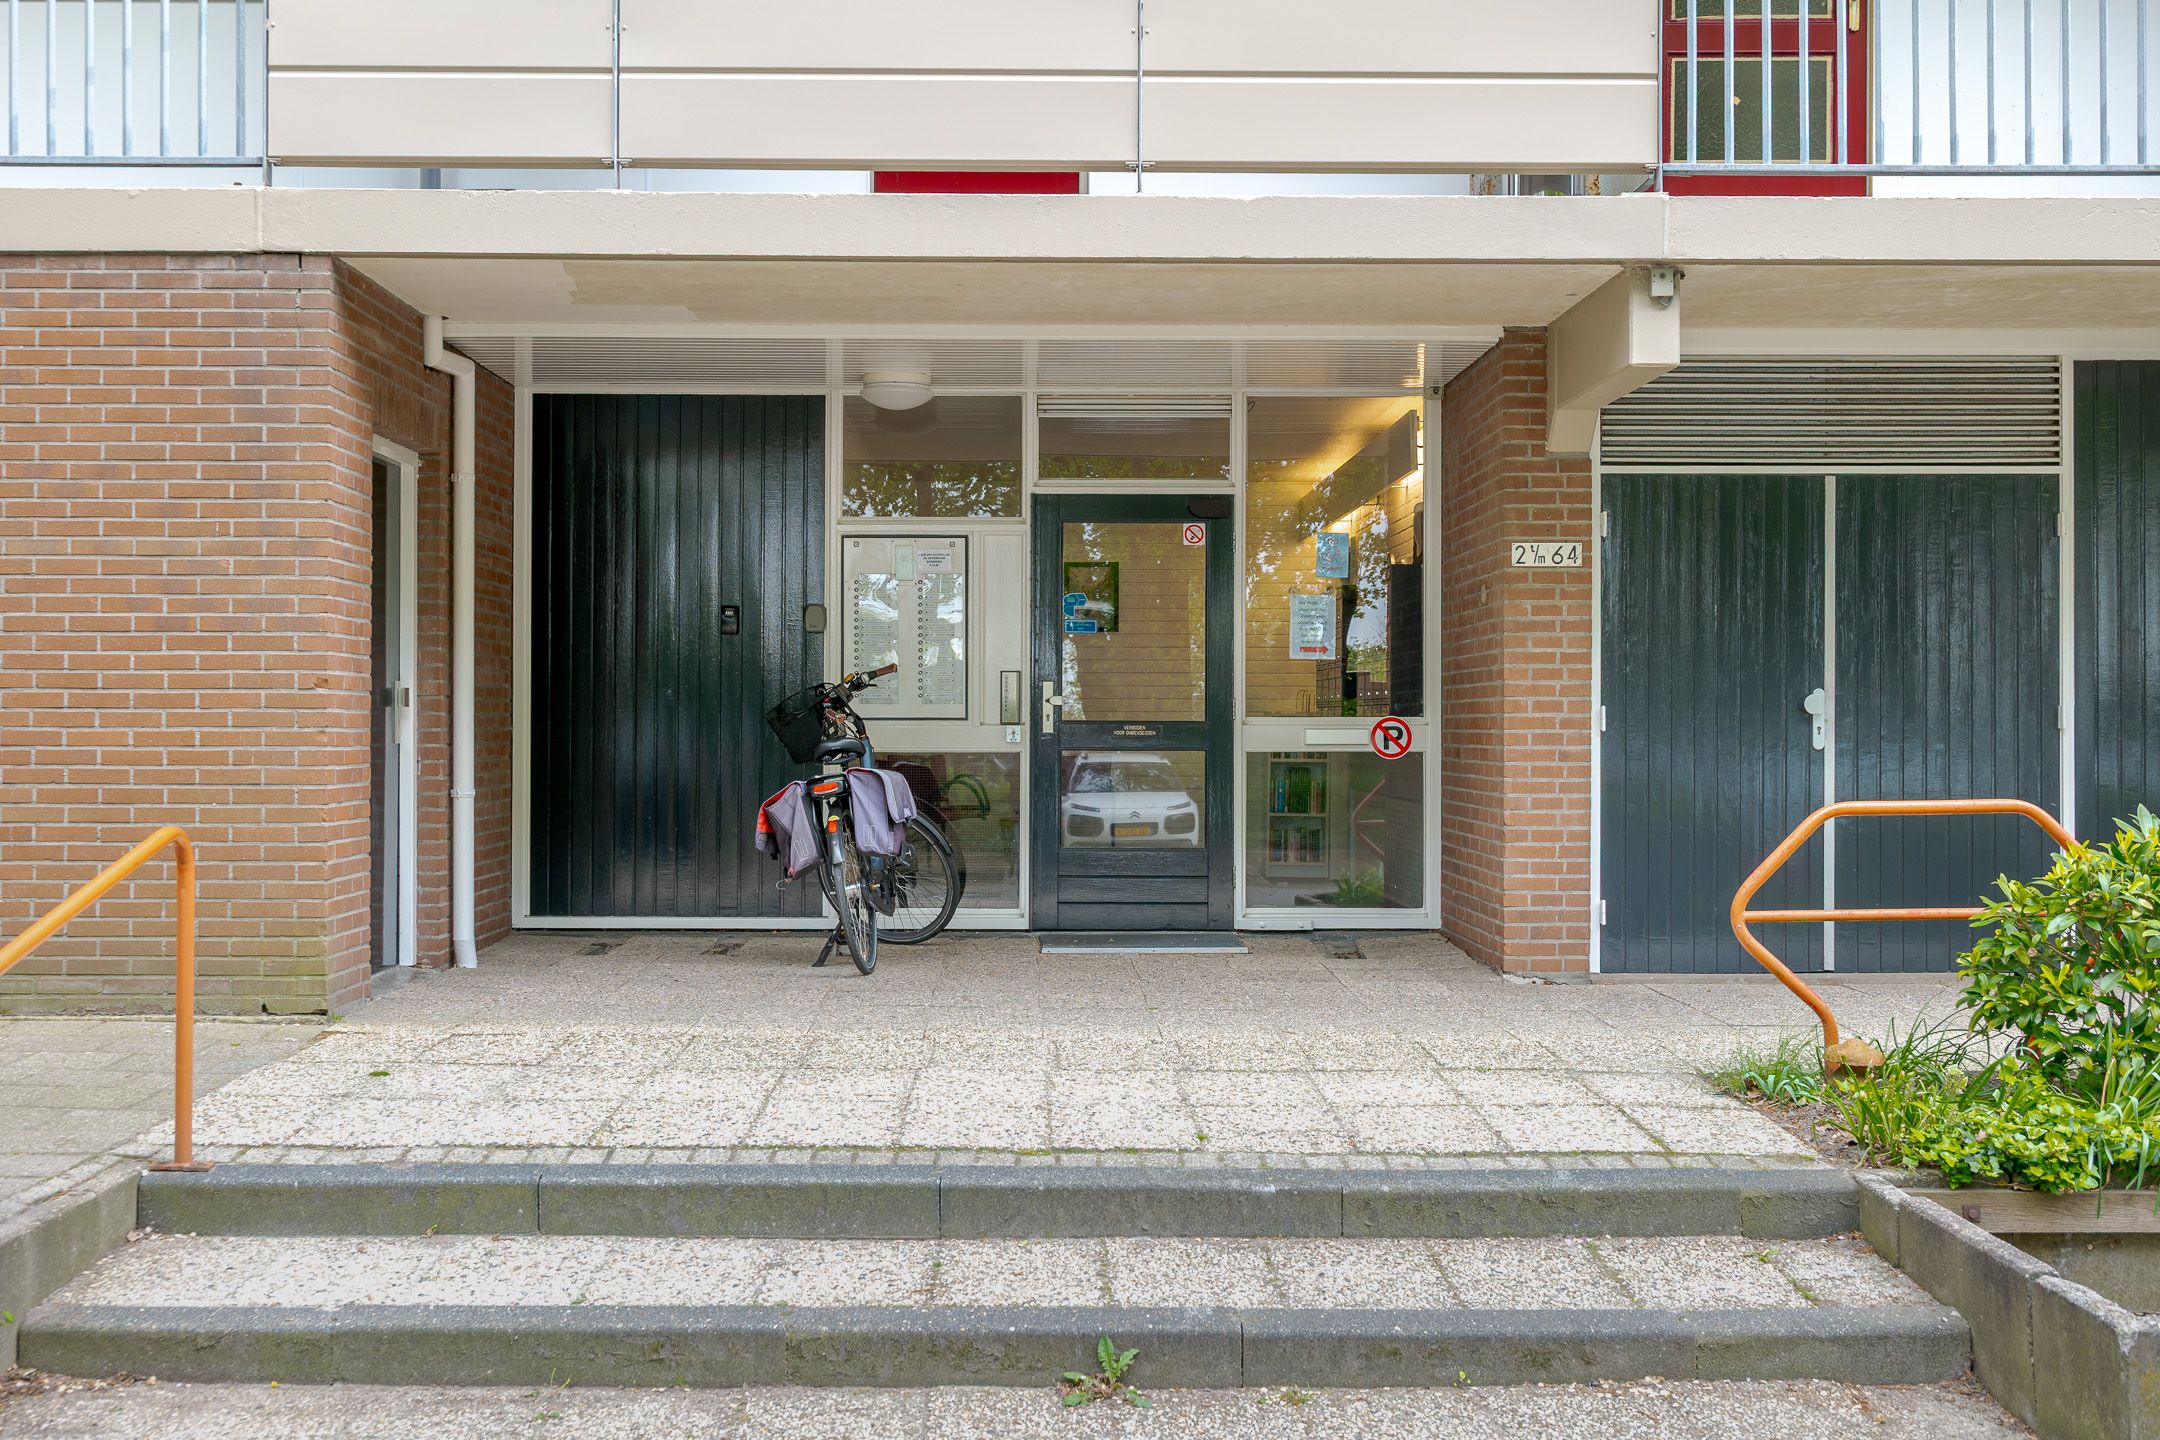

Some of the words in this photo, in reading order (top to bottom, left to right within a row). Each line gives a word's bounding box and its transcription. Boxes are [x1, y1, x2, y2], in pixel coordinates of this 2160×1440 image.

[1515, 545, 1526, 564] 2
[1551, 545, 1579, 564] 64
[1383, 726, 1403, 750] P
